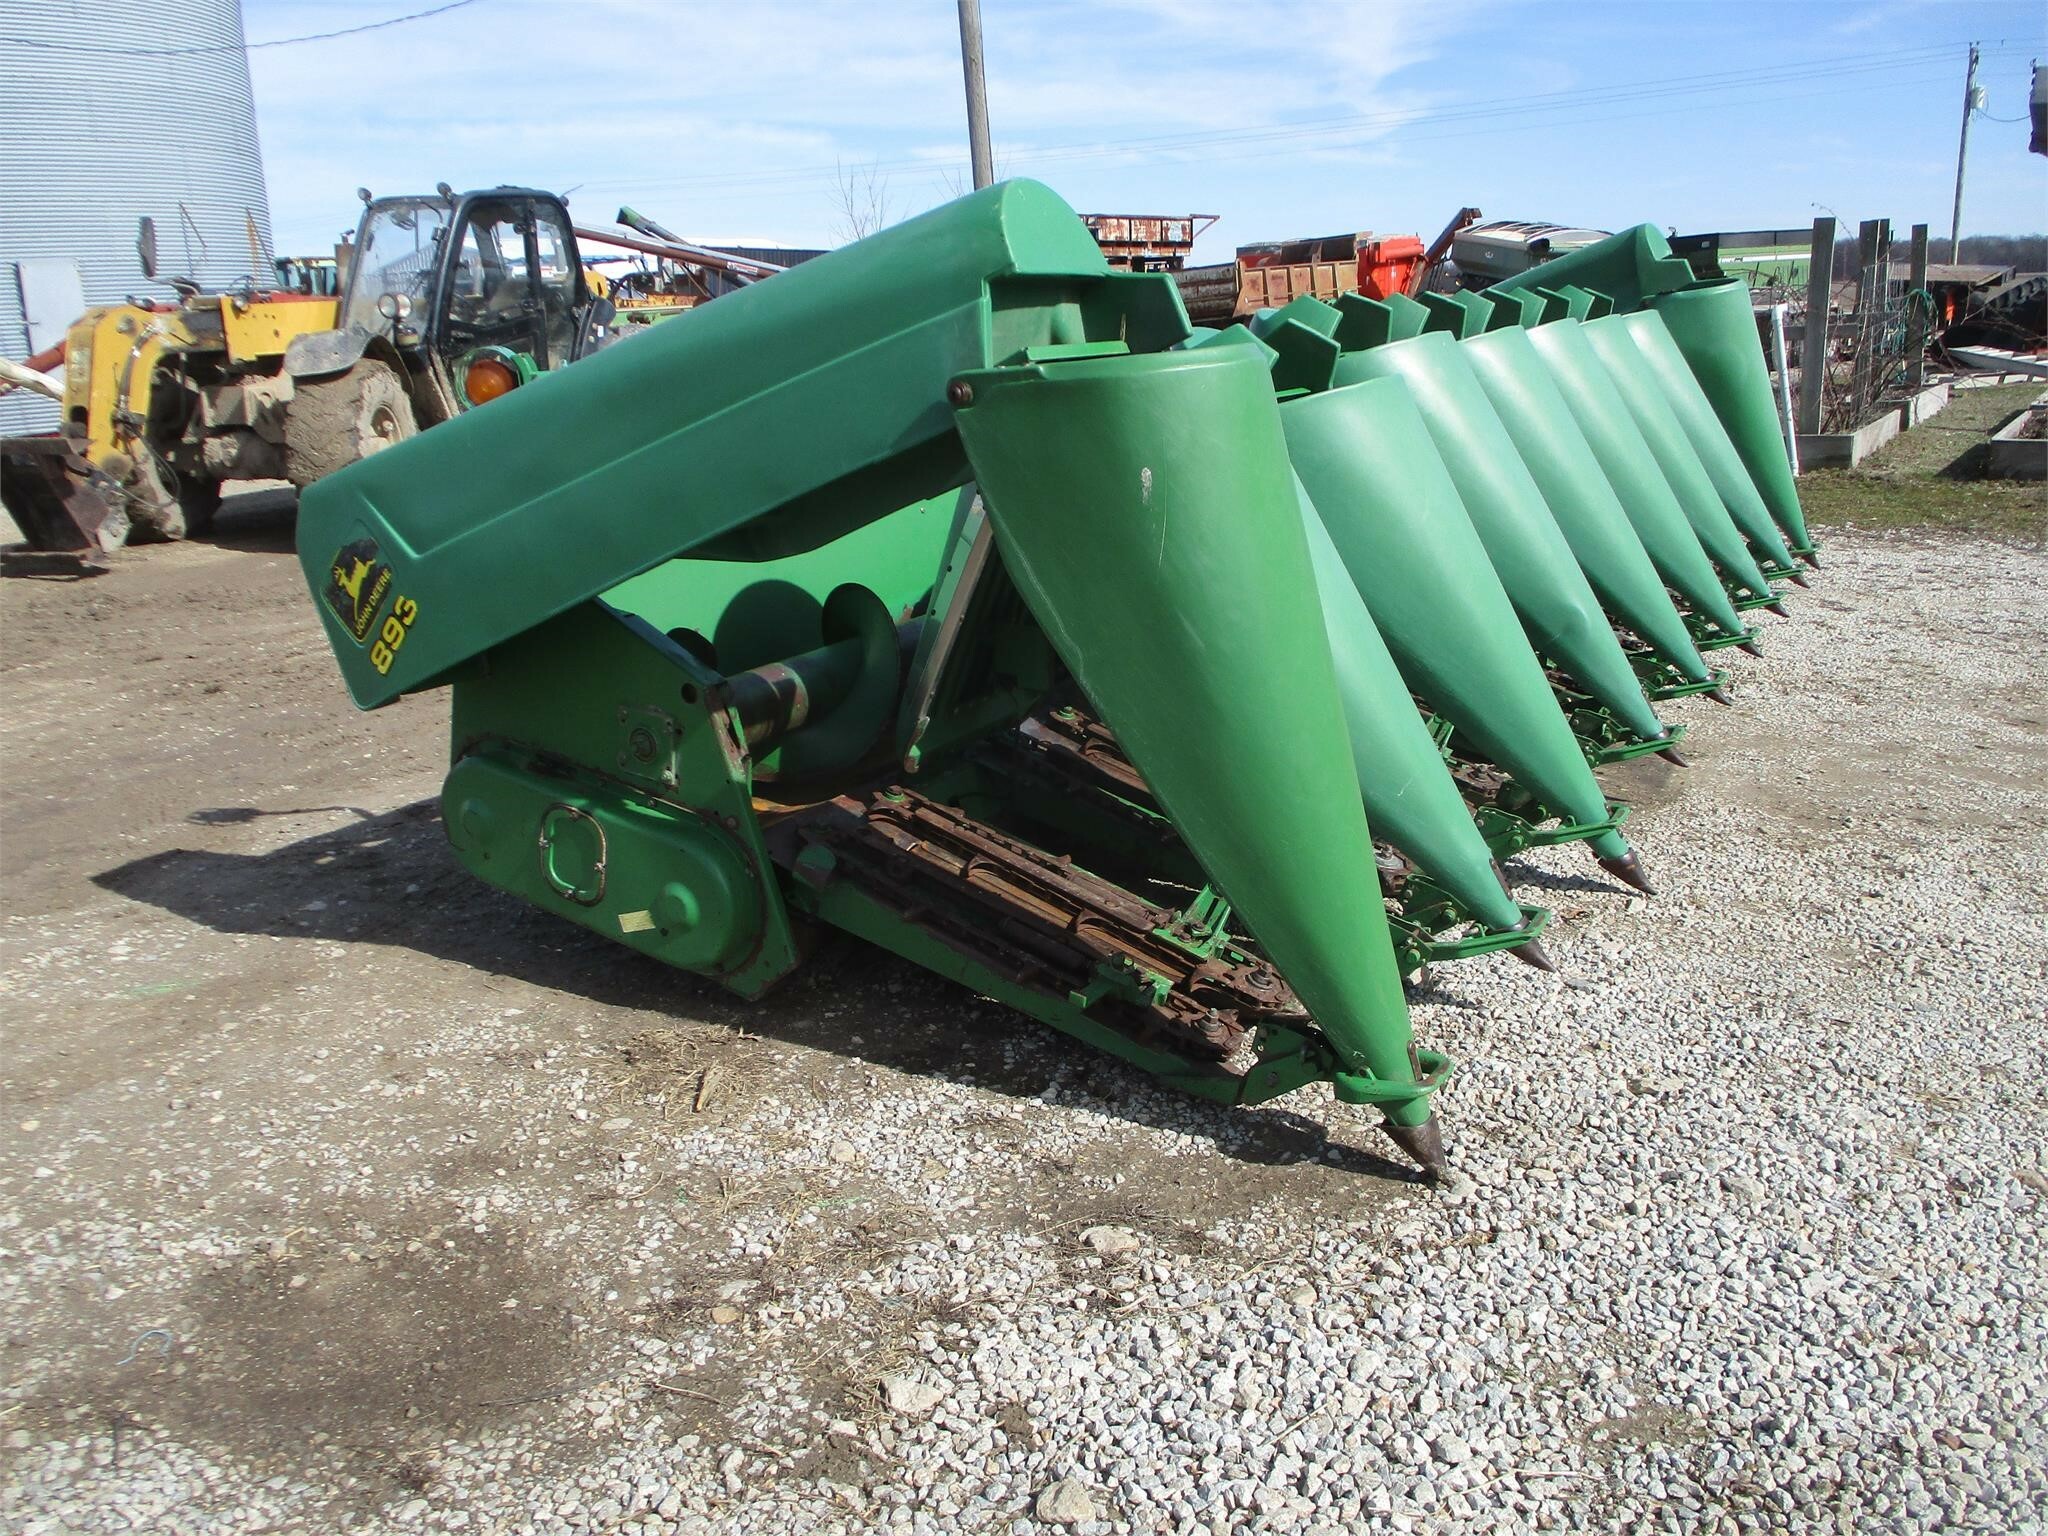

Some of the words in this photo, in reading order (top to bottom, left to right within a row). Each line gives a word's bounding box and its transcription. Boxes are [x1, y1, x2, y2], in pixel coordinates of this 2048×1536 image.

[355, 604, 373, 635] JOHN
[368, 568, 392, 606] DEERE
[370, 595, 417, 675] 893
